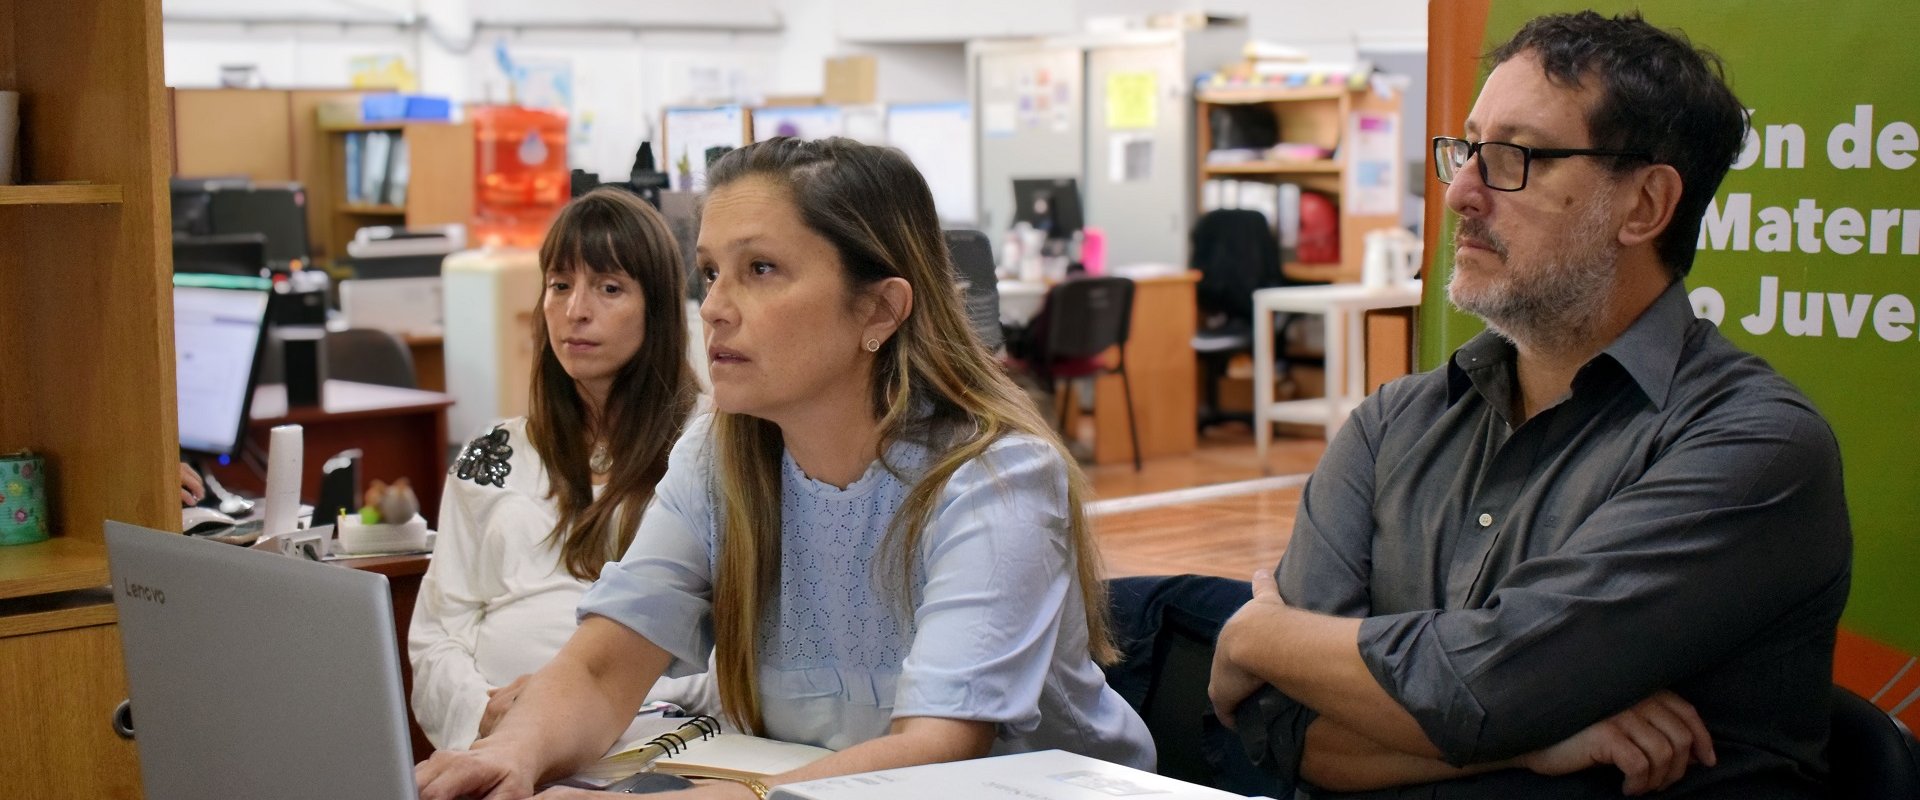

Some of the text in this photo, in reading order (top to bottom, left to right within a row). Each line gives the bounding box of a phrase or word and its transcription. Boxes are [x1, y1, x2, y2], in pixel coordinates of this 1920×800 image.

[1826, 104, 1919, 170] de
[1740, 276, 1920, 342] Juve
[124, 577, 166, 604] Lenovo
